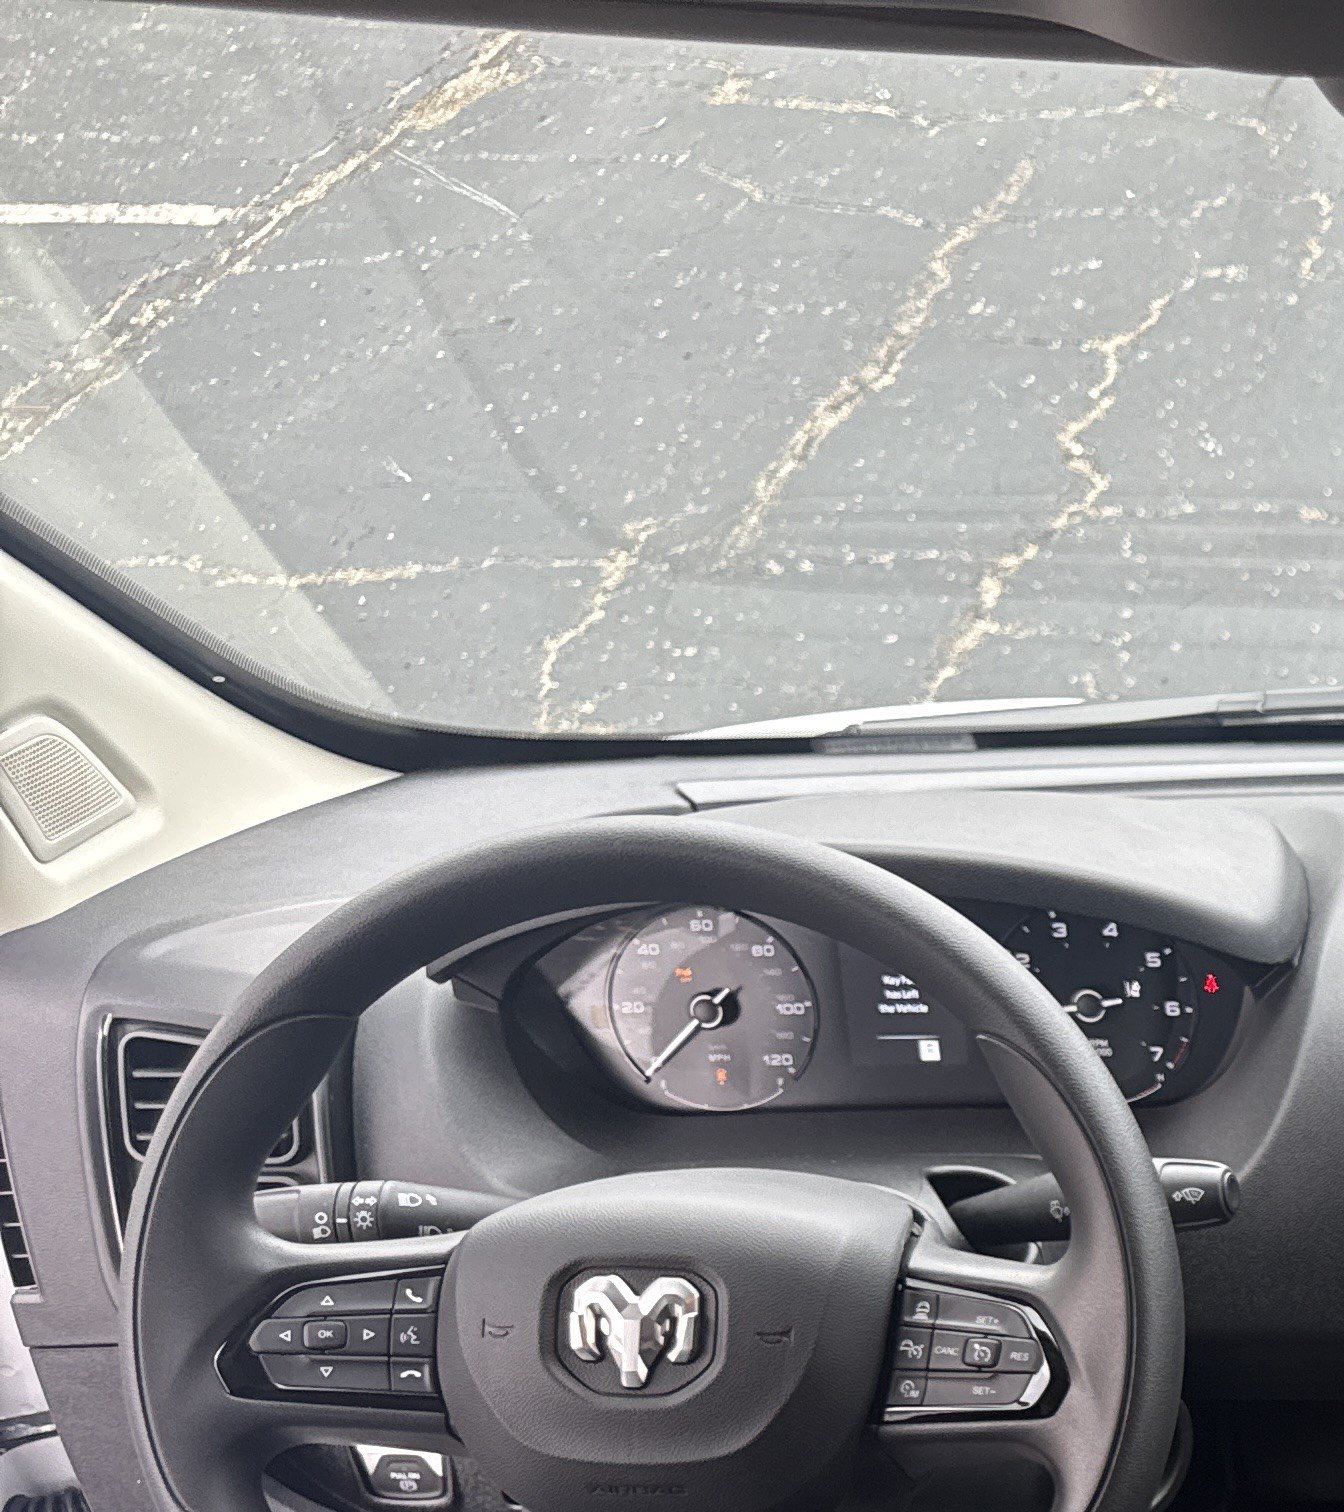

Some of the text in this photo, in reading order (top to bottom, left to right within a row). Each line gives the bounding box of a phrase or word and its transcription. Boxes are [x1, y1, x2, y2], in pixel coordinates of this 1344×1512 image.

[1051, 922, 1068, 938] 3
[1102, 923, 1119, 937] 4
[637, 944, 660, 956] 40
[751, 945, 775, 957] 80
[1144, 952, 1162, 968] 5
[621, 1001, 644, 1013] 20
[776, 1003, 805, 1015] 100
[1164, 1001, 1180, 1017] 6
[763, 1054, 793, 1066] 120
[1150, 1046, 1164, 1062] 7
[318, 1330, 334, 1338] OK
[934, 1347, 959, 1356] CANC
[1010, 1352, 1029, 1361] RES
